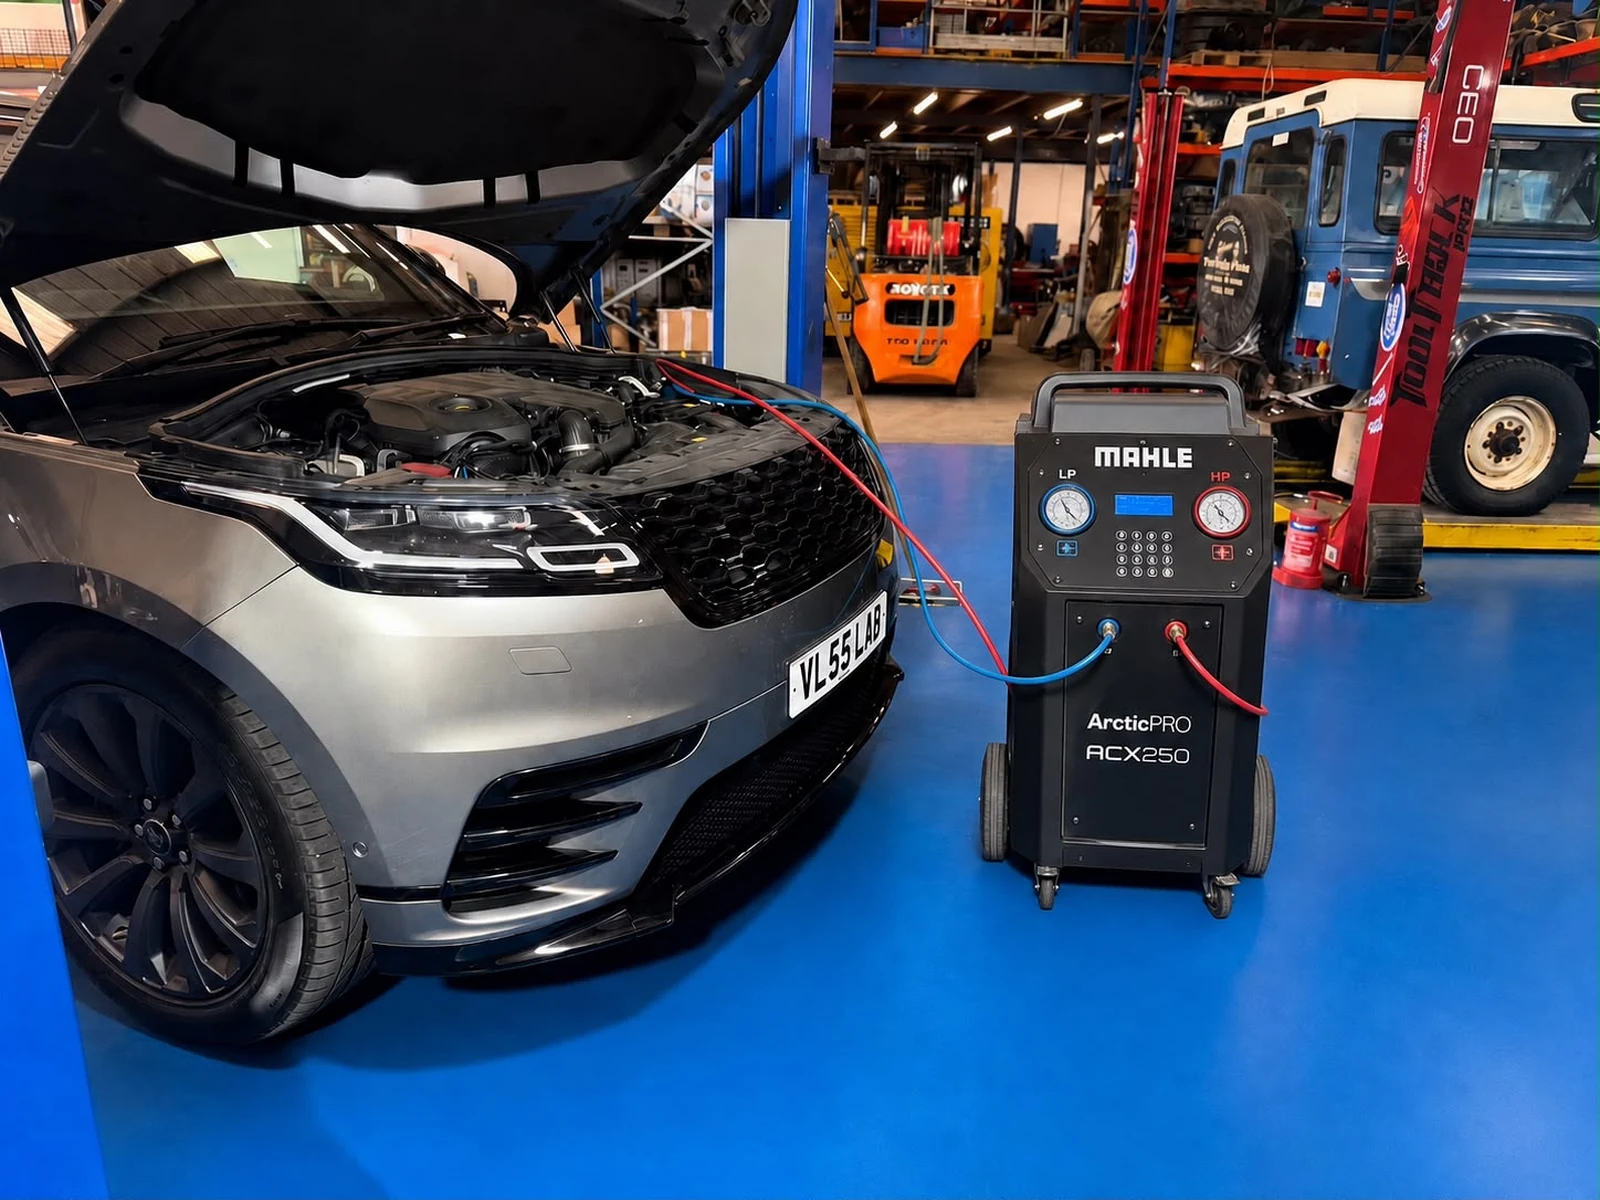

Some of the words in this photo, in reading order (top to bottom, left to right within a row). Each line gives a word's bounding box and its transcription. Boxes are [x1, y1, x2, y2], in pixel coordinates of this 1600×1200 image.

[1452, 64, 1485, 144] CEO
[1094, 446, 1193, 469] MAHLE
[1058, 469, 1077, 479] LP
[1210, 471, 1231, 482] HP
[855, 603, 881, 660] LAB
[1086, 713, 1192, 734] ArcticPRO
[1086, 744, 1190, 765] ACX250
